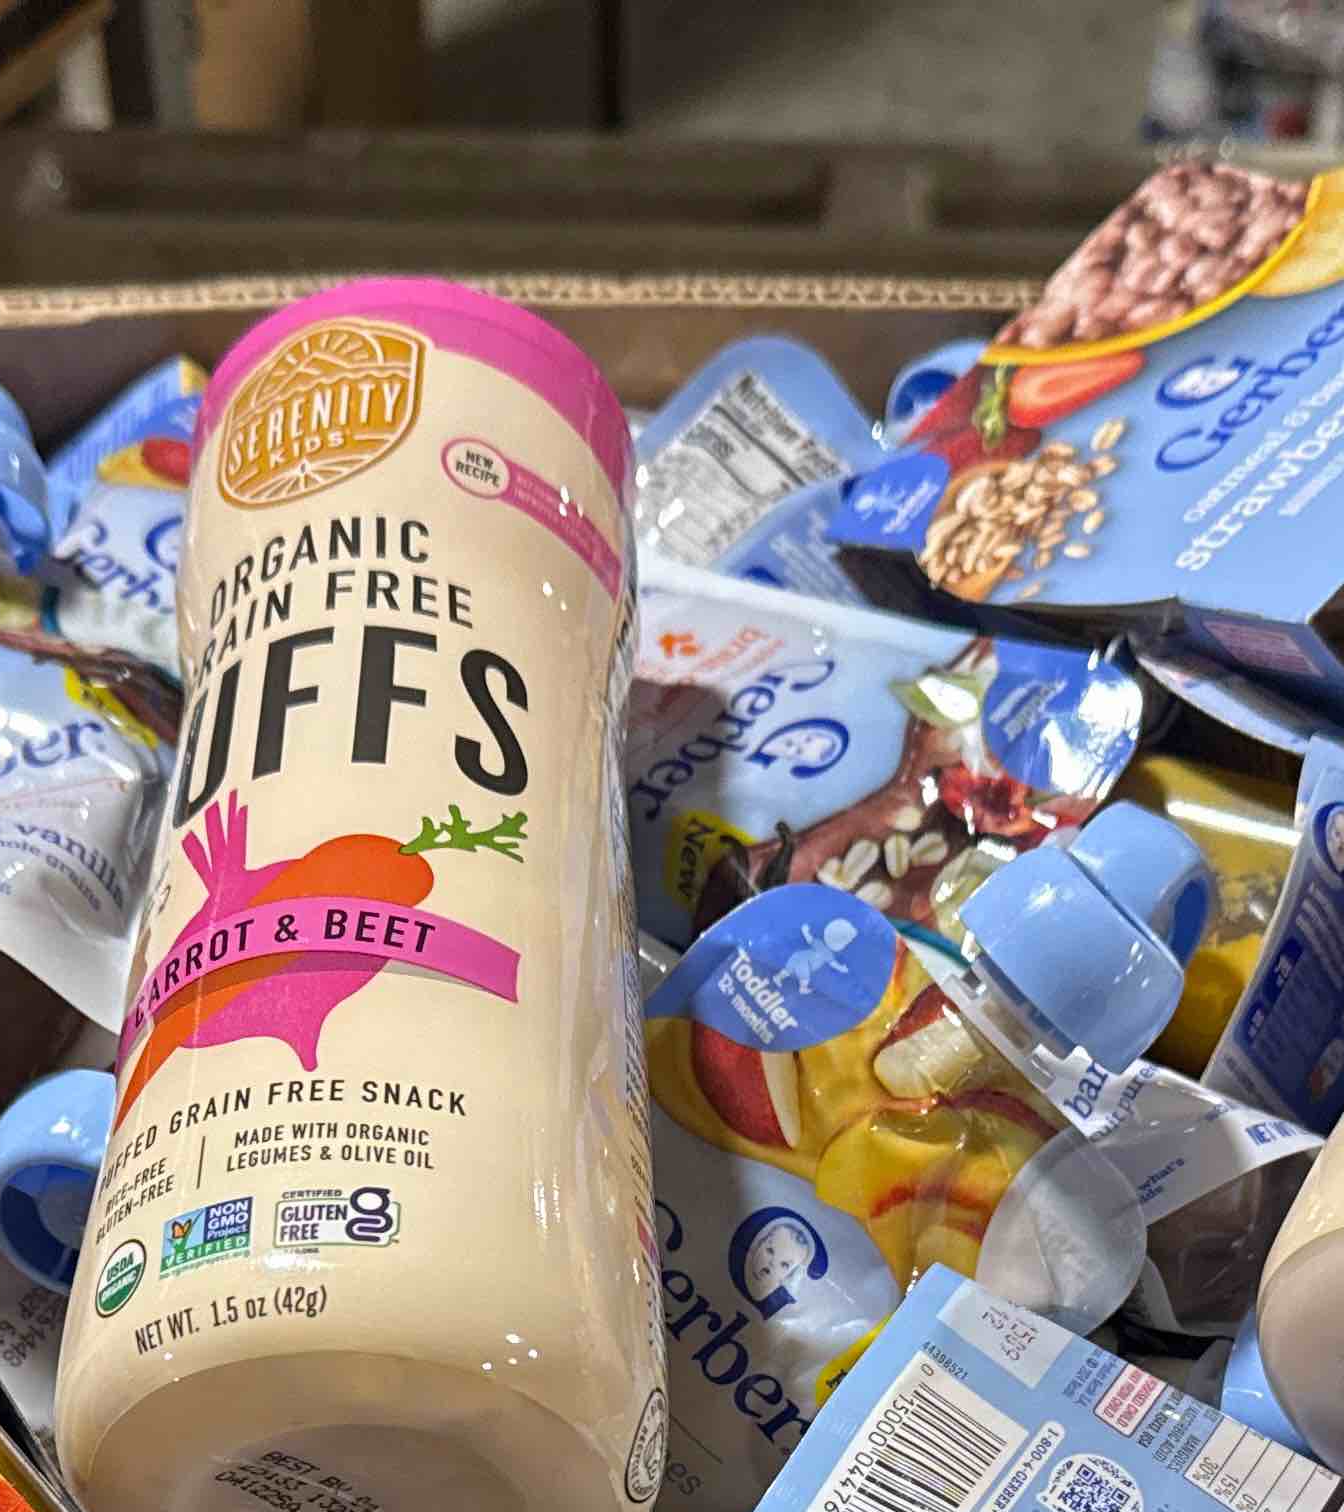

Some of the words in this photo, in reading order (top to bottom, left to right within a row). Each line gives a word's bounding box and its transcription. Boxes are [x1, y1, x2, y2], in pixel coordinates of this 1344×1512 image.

[227, 380, 405, 477] SERENITY
[268, 433, 345, 467] KIDS
[455, 459, 502, 486] RECIPE
[465, 448, 495, 468] NEW
[211, 513, 429, 629] ORGANIC
[326, 569, 473, 628] FREE
[172, 625, 528, 829] UFFS
[629, 660, 834, 819] Gerber
[676, 816, 719, 900] New
[134, 921, 255, 1026] CARROT
[274, 912, 299, 942] &
[324, 910, 436, 954] BEET
[727, 949, 800, 1032] Toddler
[727, 993, 777, 1046] months
[169, 1088, 251, 1136] GRAIN
[268, 1080, 345, 1107] FREE
[361, 1082, 468, 1117] SNACK
[234, 1129, 284, 1147] MADE
[293, 1125, 337, 1142] WITH
[346, 1123, 430, 1146] ORGANIC
[226, 1146, 311, 1172] LEGUMES
[341, 1145, 396, 1166] OLIVE
[403, 1149, 434, 1171] OIL
[208, 1200, 248, 1218] NON
[279, 1223, 319, 1242] FREE
[280, 1204, 348, 1224] GLUTEN
[165, 1235, 248, 1268] VERIFIED
[134, 1318, 164, 1355] NET
[247, 1296, 268, 1320] oz
[274, 1284, 327, 1320] (42g)
[921, 1362, 934, 1376] 0
[868, 1394, 914, 1448] 15000
[997, 1427, 1060, 1510] 1-800-4-GERBER
